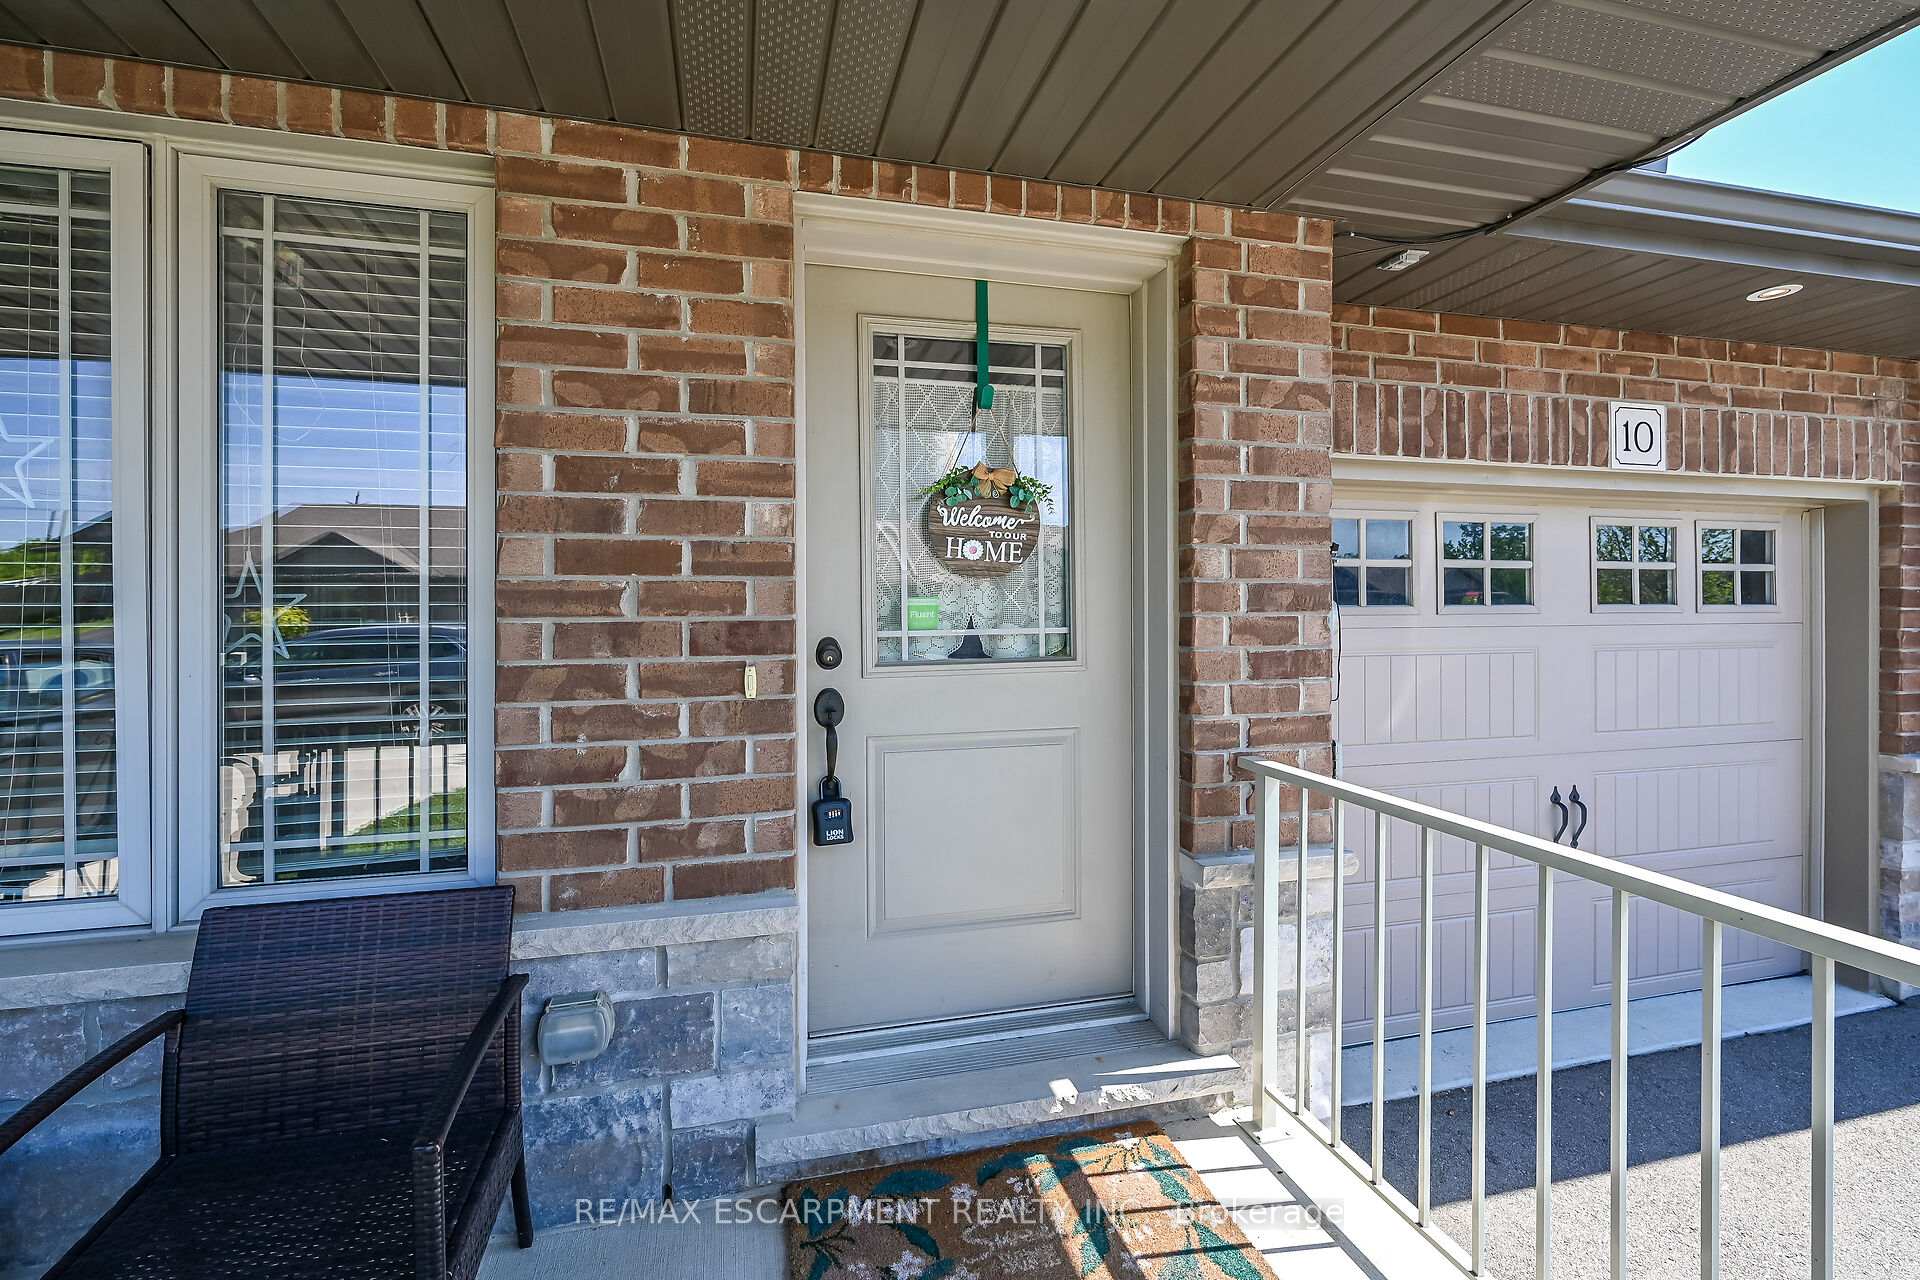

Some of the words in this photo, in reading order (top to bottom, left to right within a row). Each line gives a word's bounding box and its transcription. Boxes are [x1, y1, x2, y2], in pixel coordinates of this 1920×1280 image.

[1623, 420, 1653, 453] 10
[937, 504, 1035, 529] Welcome
[989, 530, 1002, 538] TO
[1004, 531, 1027, 540] OUR
